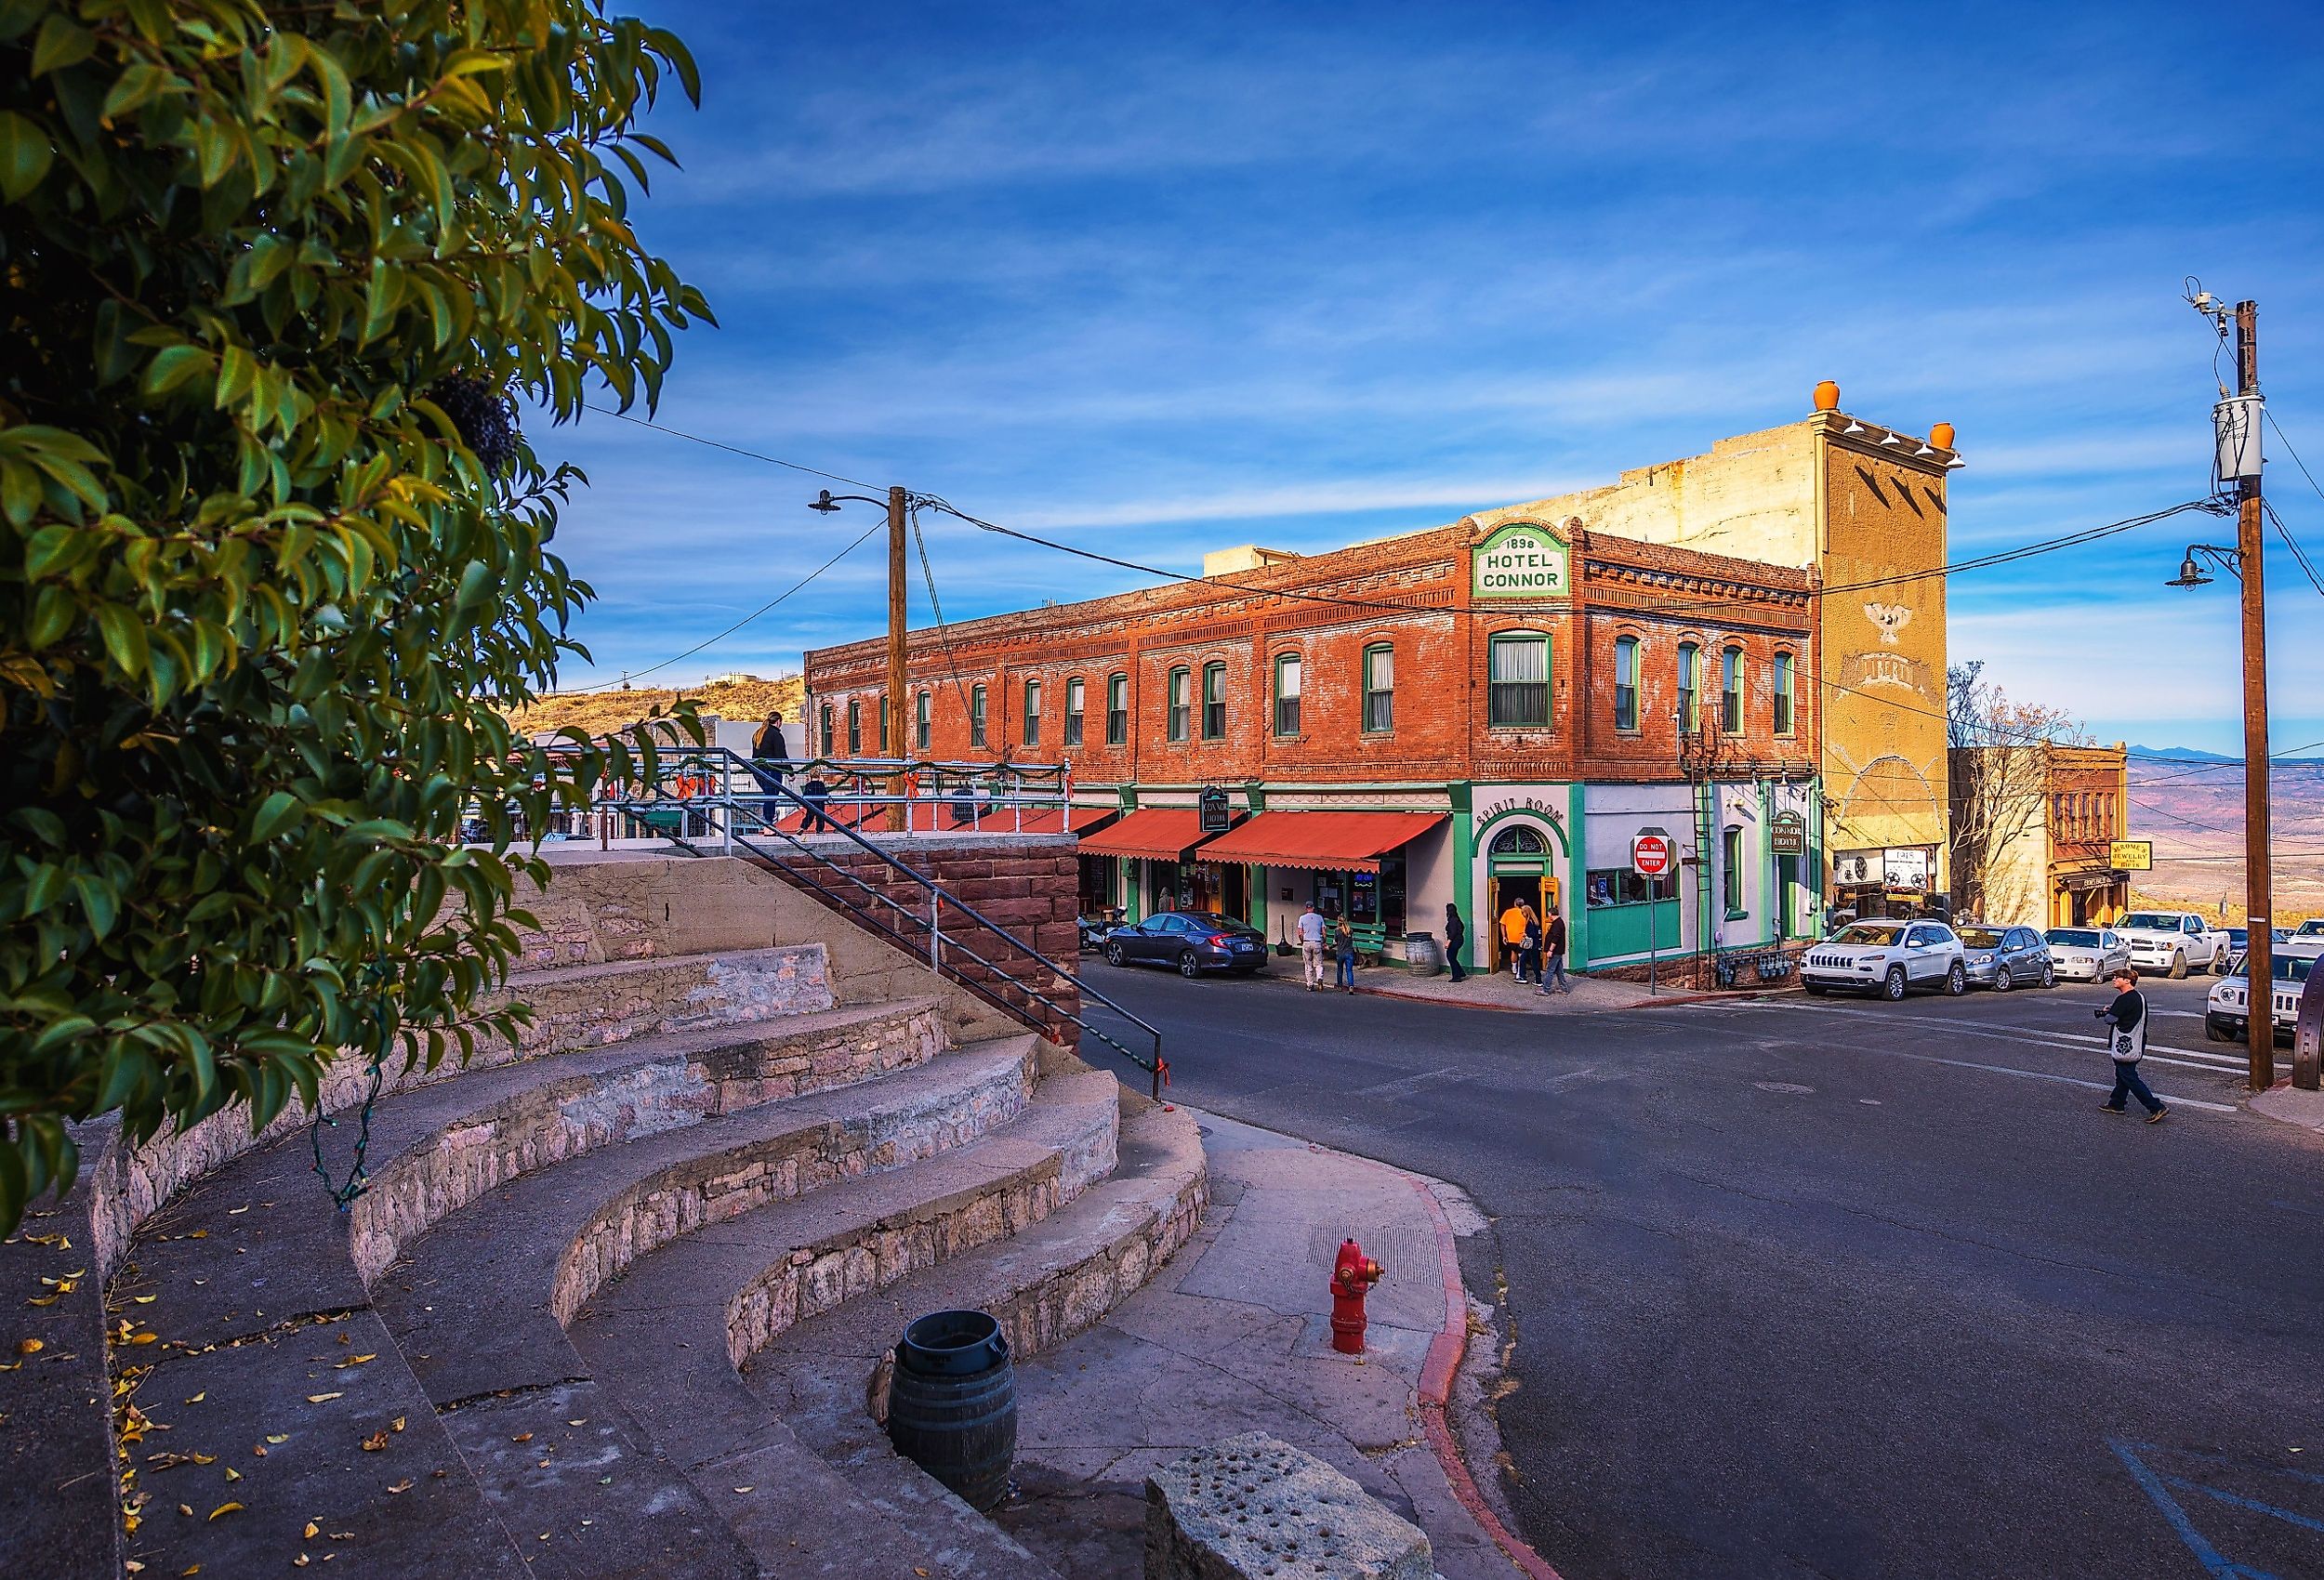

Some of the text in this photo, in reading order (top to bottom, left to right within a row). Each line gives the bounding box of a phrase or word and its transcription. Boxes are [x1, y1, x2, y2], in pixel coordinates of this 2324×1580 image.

[1506, 538, 1535, 549] 1898
[1487, 554, 1553, 568] HOTEL
[1484, 573, 1558, 587] CONNOR
[1476, 797, 1564, 825] SPIRIT ROOM
[1642, 859, 1661, 867] ENTER
